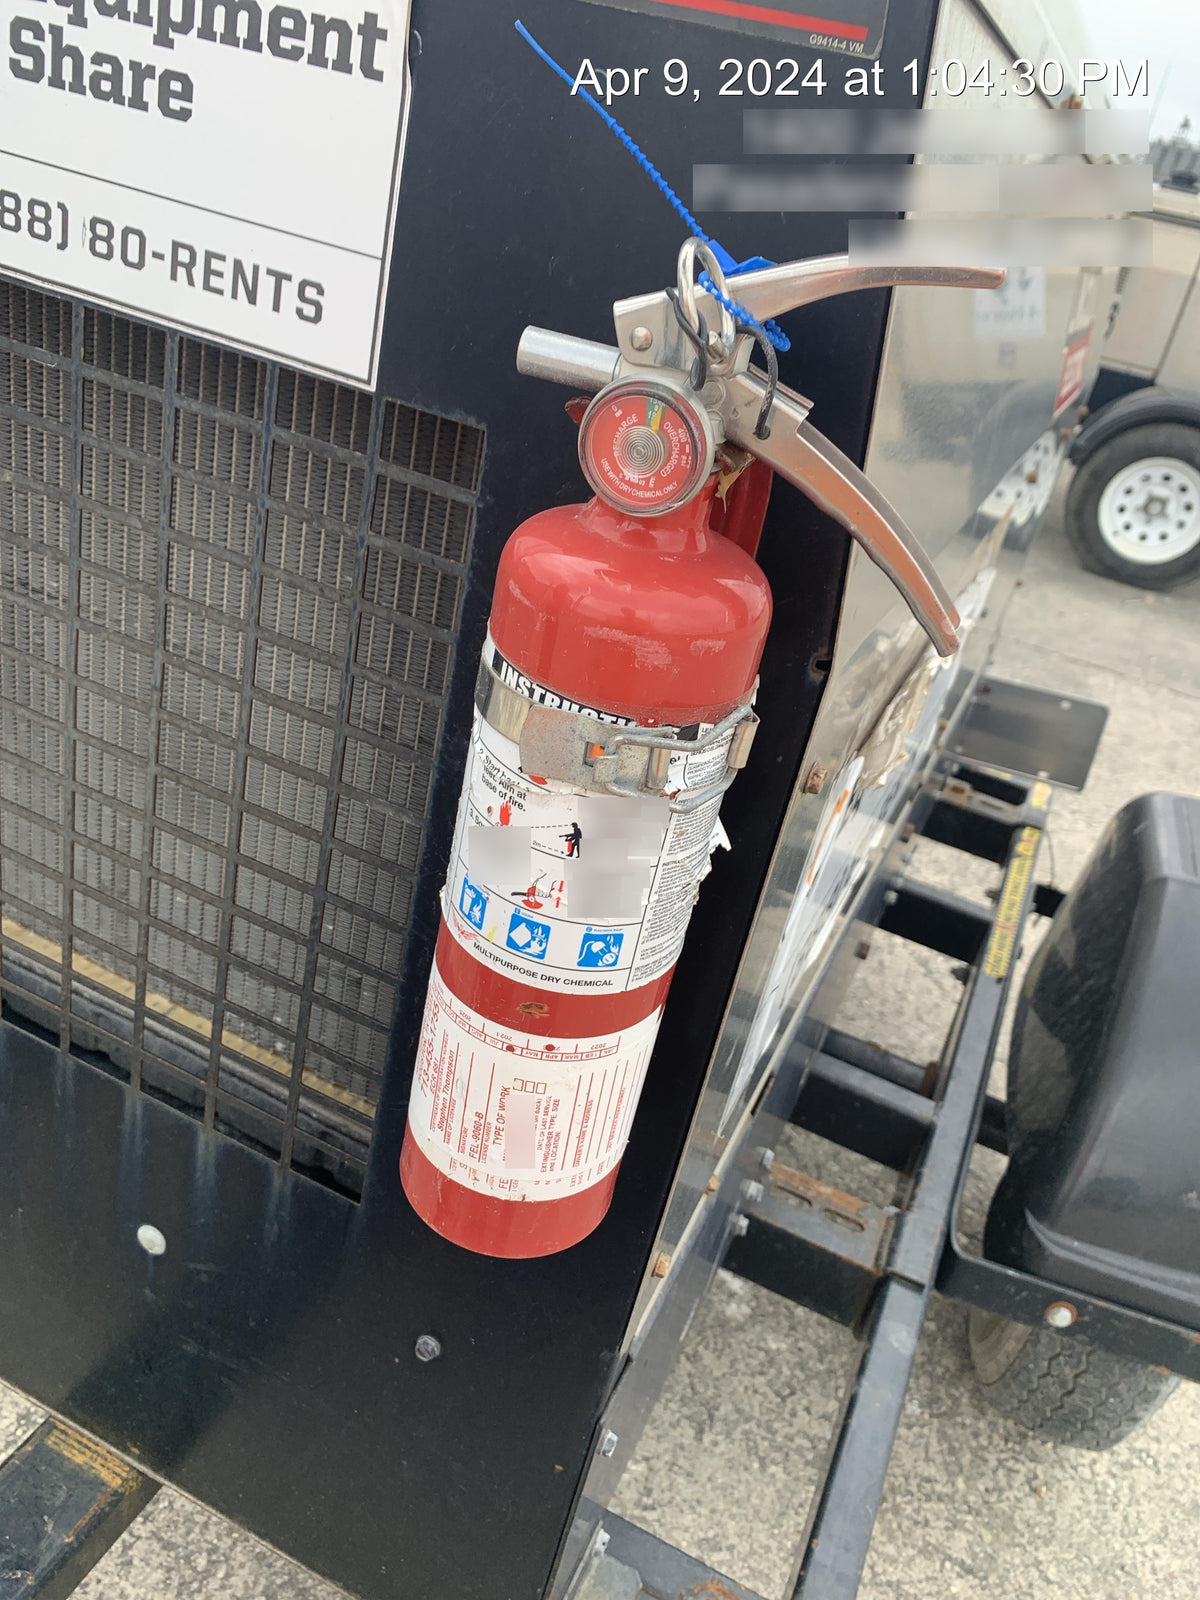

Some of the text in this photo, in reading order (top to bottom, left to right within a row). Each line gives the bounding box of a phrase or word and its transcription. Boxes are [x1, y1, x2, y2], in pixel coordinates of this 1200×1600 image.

[18, 0, 388, 82] pment
[809, 33, 864, 54] G9414-4 VM
[9, 15, 194, 122] Share
[89, 216, 325, 325] 80-RENTS
[660, 421, 680, 478] OVERCHARGED
[677, 428, 688, 443] 400
[600, 457, 610, 473] USE
[607, 468, 621, 486] WITH
[619, 481, 633, 494] DRY
[631, 487, 664, 498] CHEMICAL
[663, 480, 678, 494] ONLY
[484, 755, 500, 776] Start
[482, 773, 498, 793] base
[498, 790, 508, 801] of
[508, 796, 526, 812] fire.
[498, 780, 515, 794] Aim
[516, 790, 527, 801] at
[473, 941, 613, 987] MULTIPURPOSE DRY CHEMICAL
[420, 1002, 440, 1098] 713-455-1755
[437, 1050, 455, 1132] Stephen Thompson
[469, 1111, 484, 1160] FEL-9060-B
[493, 1086, 511, 1146] TYPE OF WORK
[541, 1131, 553, 1172] EXTINGUISHER
[552, 1099, 560, 1112] SIZE
[481, 1142, 489, 1164] LICENSE
